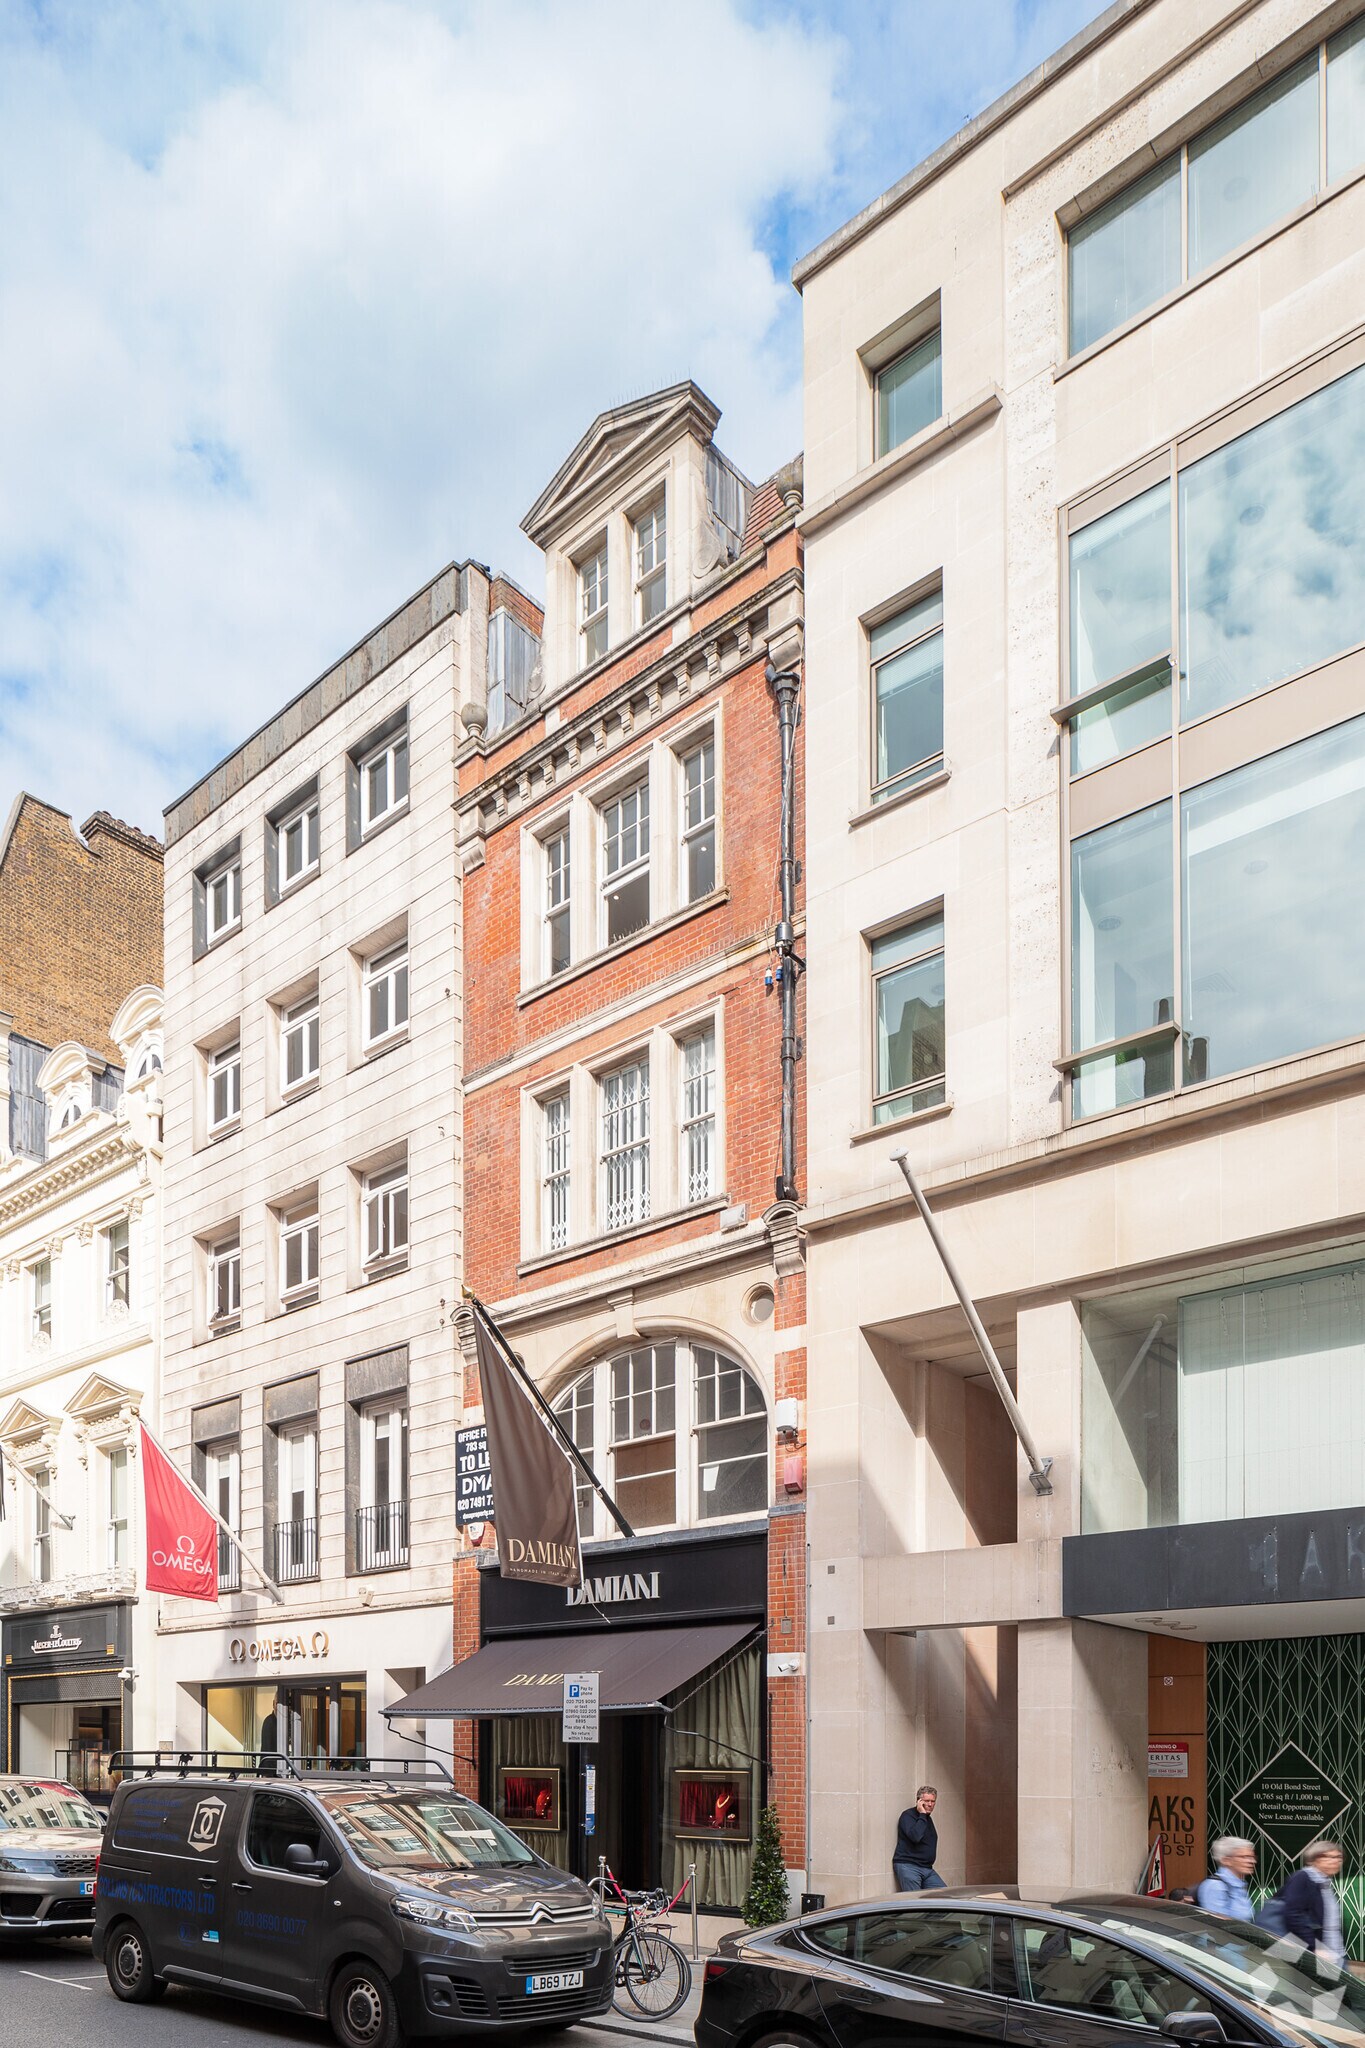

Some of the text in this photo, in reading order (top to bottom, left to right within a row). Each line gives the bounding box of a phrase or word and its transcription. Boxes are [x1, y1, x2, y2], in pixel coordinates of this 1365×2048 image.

[457, 1429, 480, 1443] OFFICE
[465, 1442, 477, 1452] 783
[460, 1454, 476, 1472] TO
[457, 1498, 470, 1511] 020
[470, 1496, 486, 1509] 7491
[507, 1538, 577, 1569] DAMIANI
[152, 1550, 213, 1576] OMEGA
[565, 1571, 661, 1607] DAMIANI
[250, 1636, 307, 1662] OMEGA
[1284, 1783, 1301, 1791] Bond
[1302, 1783, 1321, 1791] Street
[1295, 1793, 1313, 1801] 1,000
[1148, 1795, 1194, 1833] AKS
[1258, 1812, 1273, 1820] New
[1294, 1813, 1324, 1821] Available
[1282, 1803, 1323, 1812] Opportunity)
[1160, 1832, 1194, 1844] OLD
[197, 1892, 216, 1915] LTD
[237, 1909, 255, 1928] 020
[281, 1915, 308, 1936] 0077
[532, 1972, 581, 1991] LB69 TZJ
